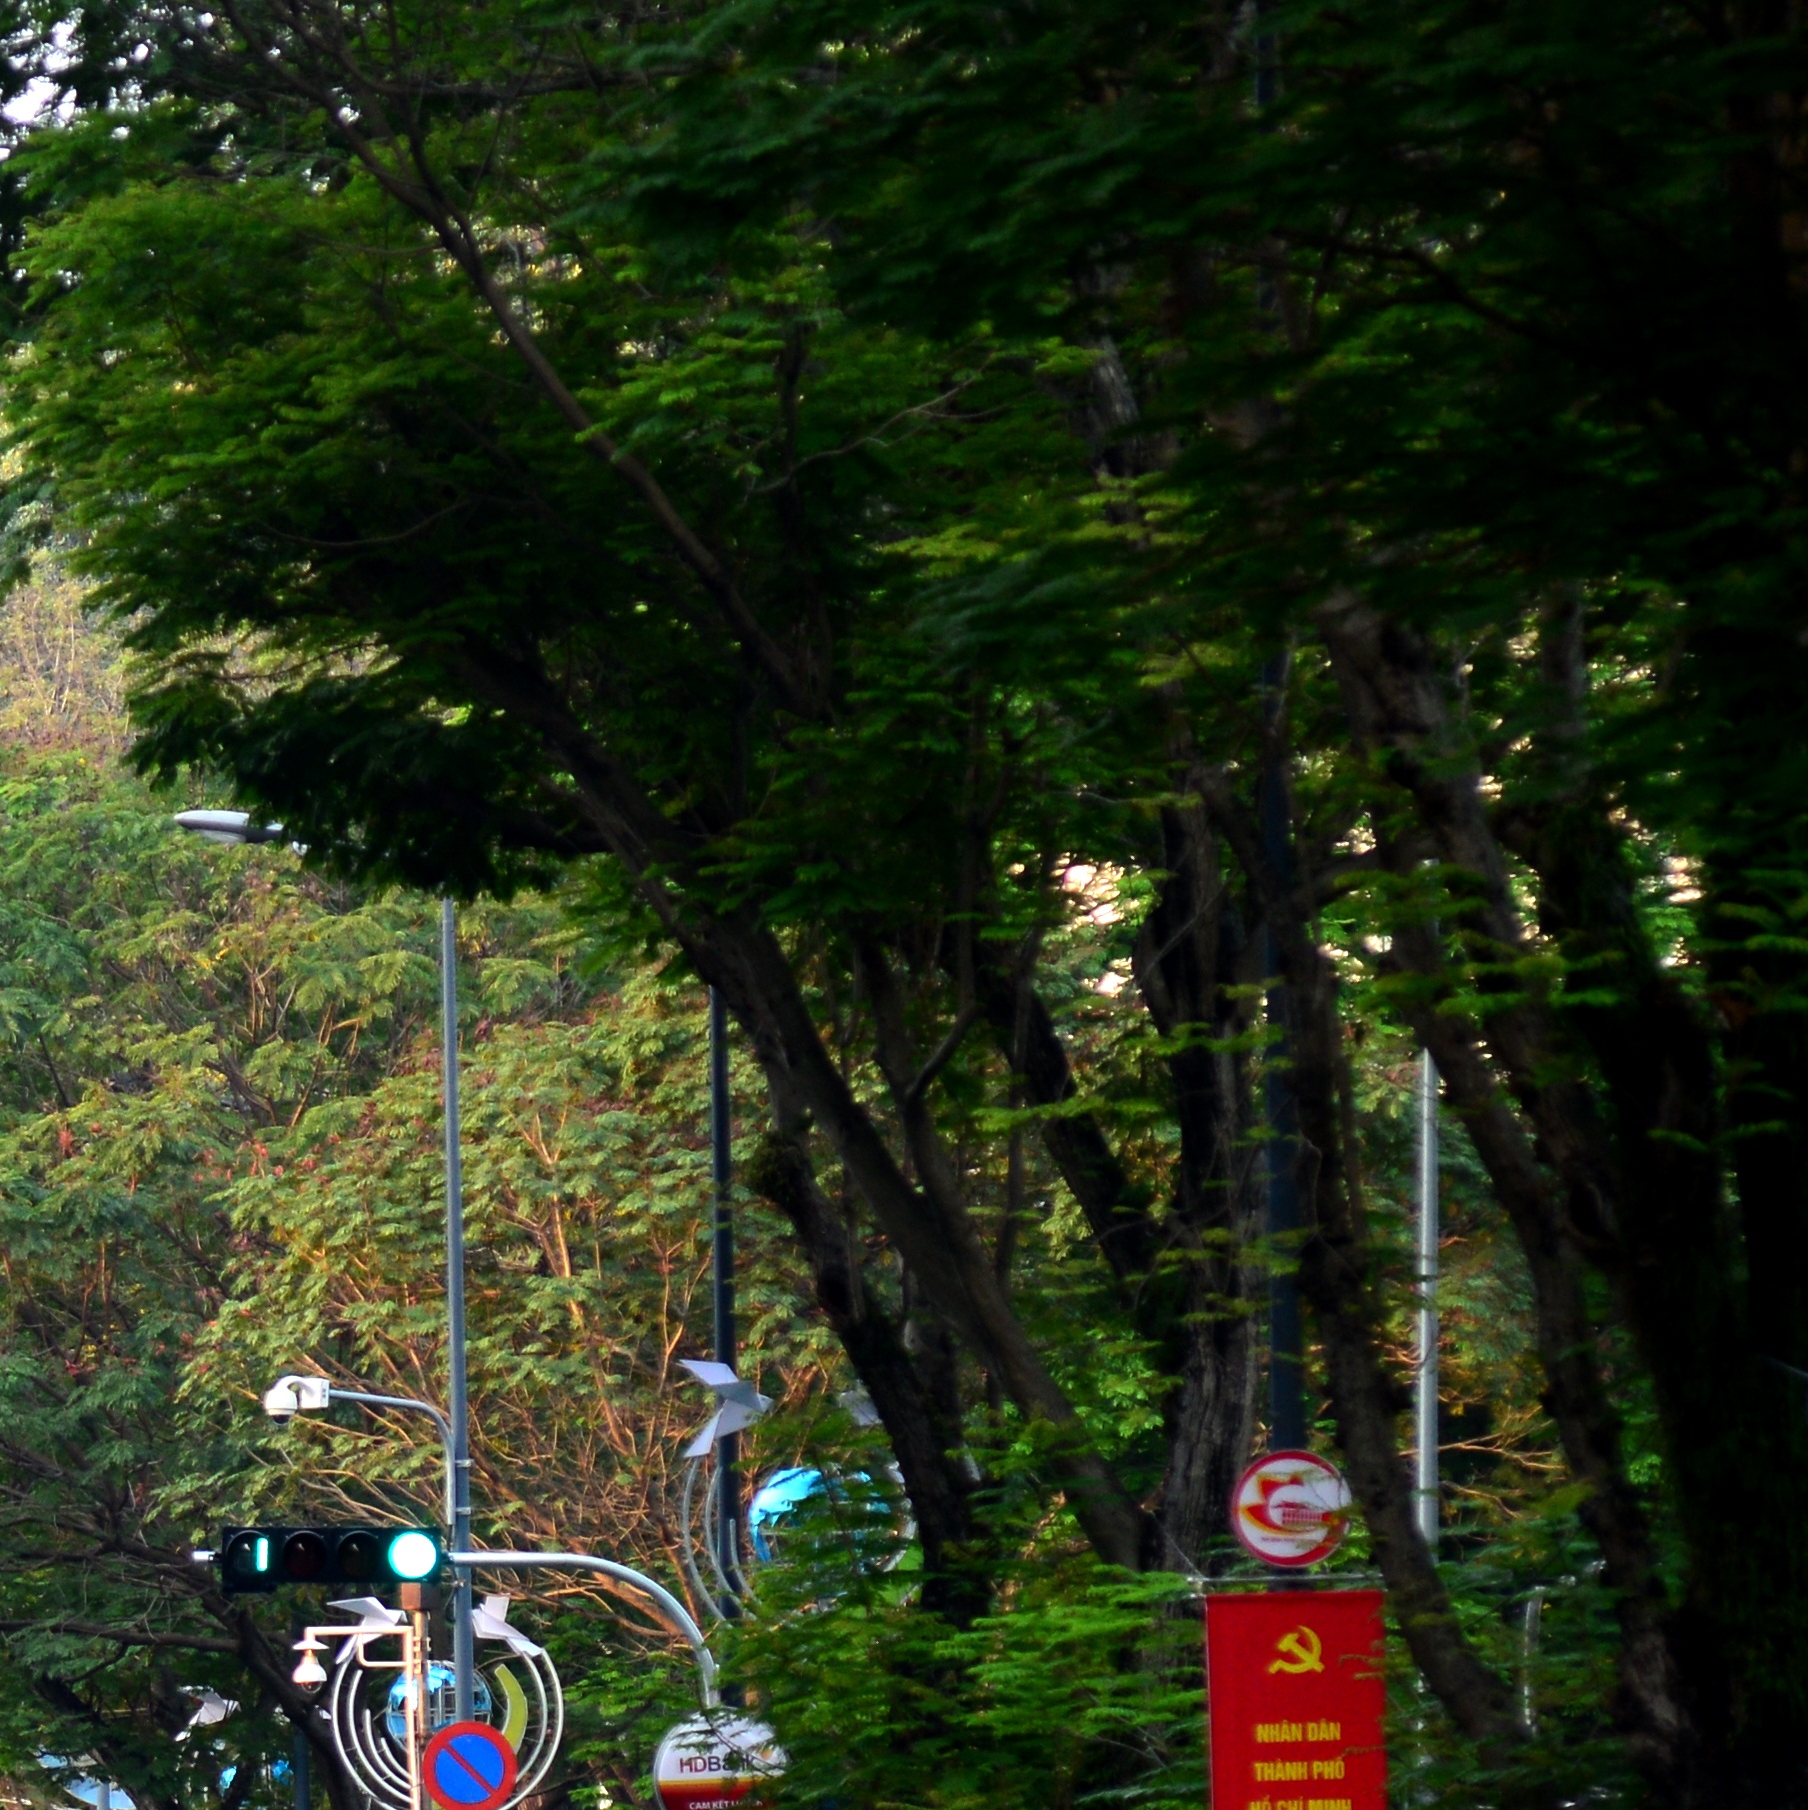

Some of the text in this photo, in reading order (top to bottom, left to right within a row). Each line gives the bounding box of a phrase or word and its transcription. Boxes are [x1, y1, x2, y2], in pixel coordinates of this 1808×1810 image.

[1255, 1718, 1341, 1743] NHÂN DÂN
[1254, 1757, 1345, 1781] THÀNH PHỐ
